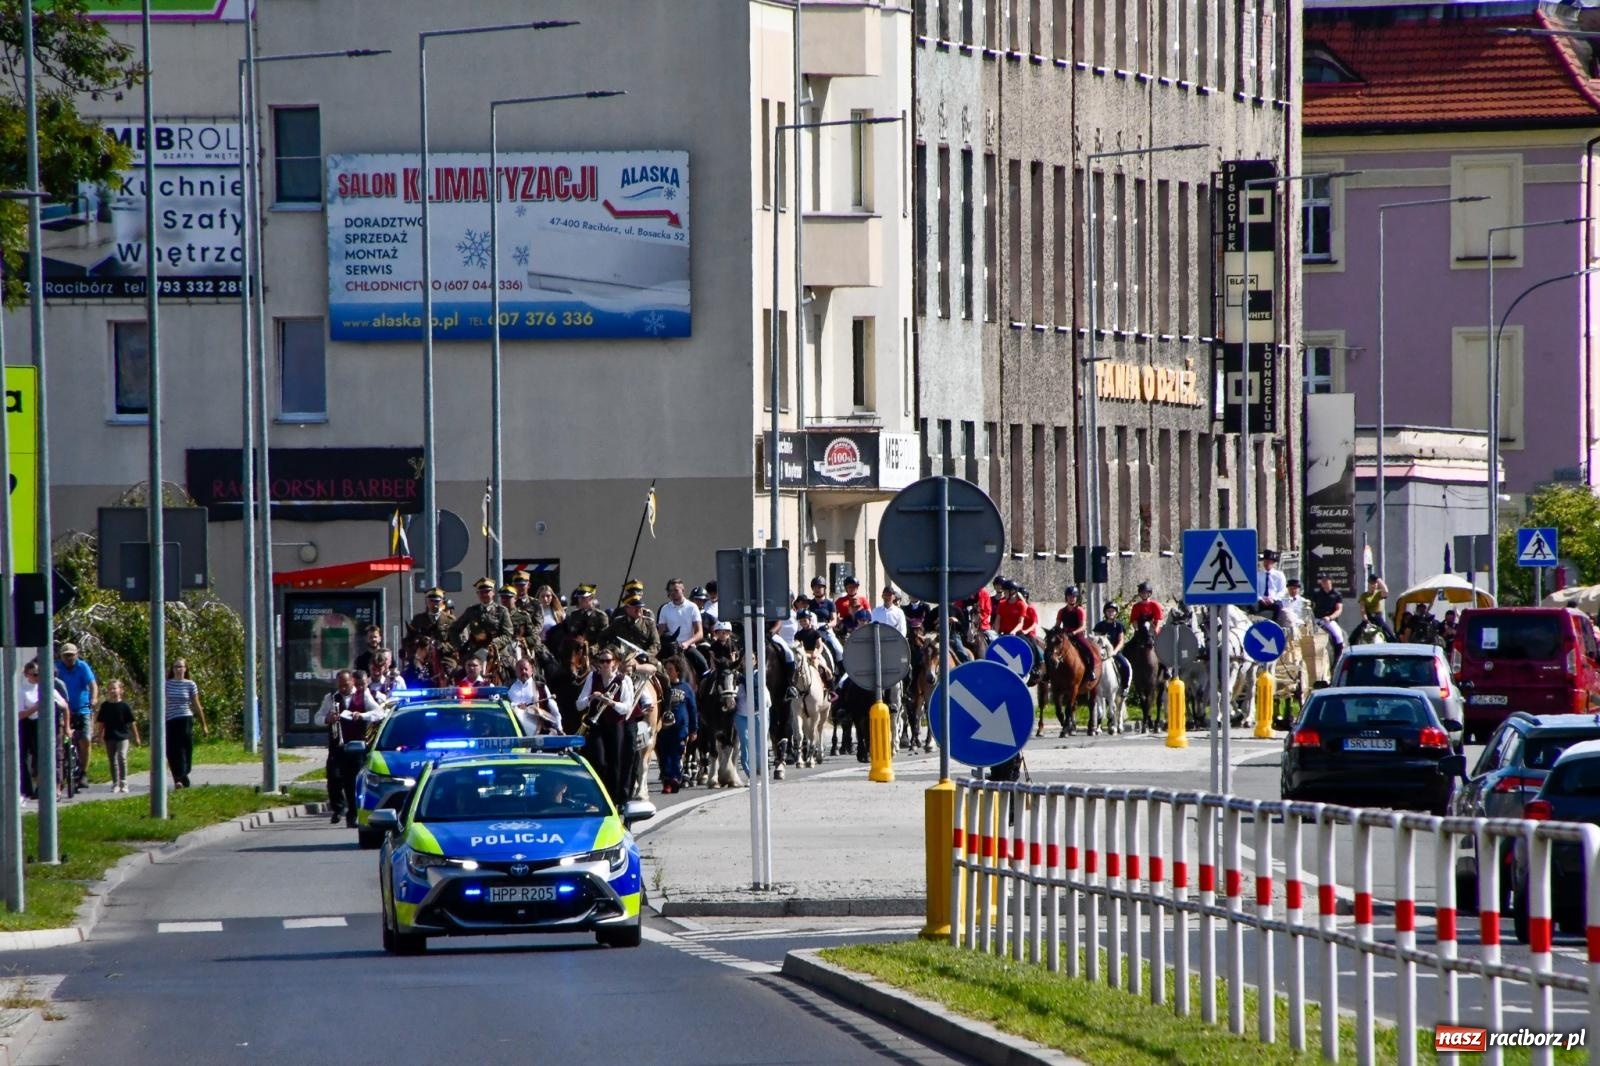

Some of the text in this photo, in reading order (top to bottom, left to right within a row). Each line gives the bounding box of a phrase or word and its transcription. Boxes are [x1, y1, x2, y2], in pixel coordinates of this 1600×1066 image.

[338, 166, 598, 202] SALON KIMATYZACJI
[620, 165, 680, 189] ALASKA
[1228, 164, 1236, 250] DISCOTHEK
[549, 217, 580, 228] 47-400
[637, 229, 671, 240] Bosacka
[674, 232, 686, 241] 52
[344, 230, 408, 244] SPRZEDAŻ
[344, 246, 399, 260] MONTAŻ
[345, 264, 393, 276] SERWIS
[45, 281, 113, 293] Racibórz
[187, 282, 214, 293] 332
[444, 280, 469, 292] (607
[498, 279, 523, 292] 336)
[526, 312, 557, 326] 376
[562, 311, 594, 326] 336
[1096, 361, 1140, 401] TANIA
[342, 479, 417, 498] BARBER
[1335, 547, 1352, 555] 50m
[471, 833, 565, 847] POLICJA
[492, 887, 553, 900] HPP R205
